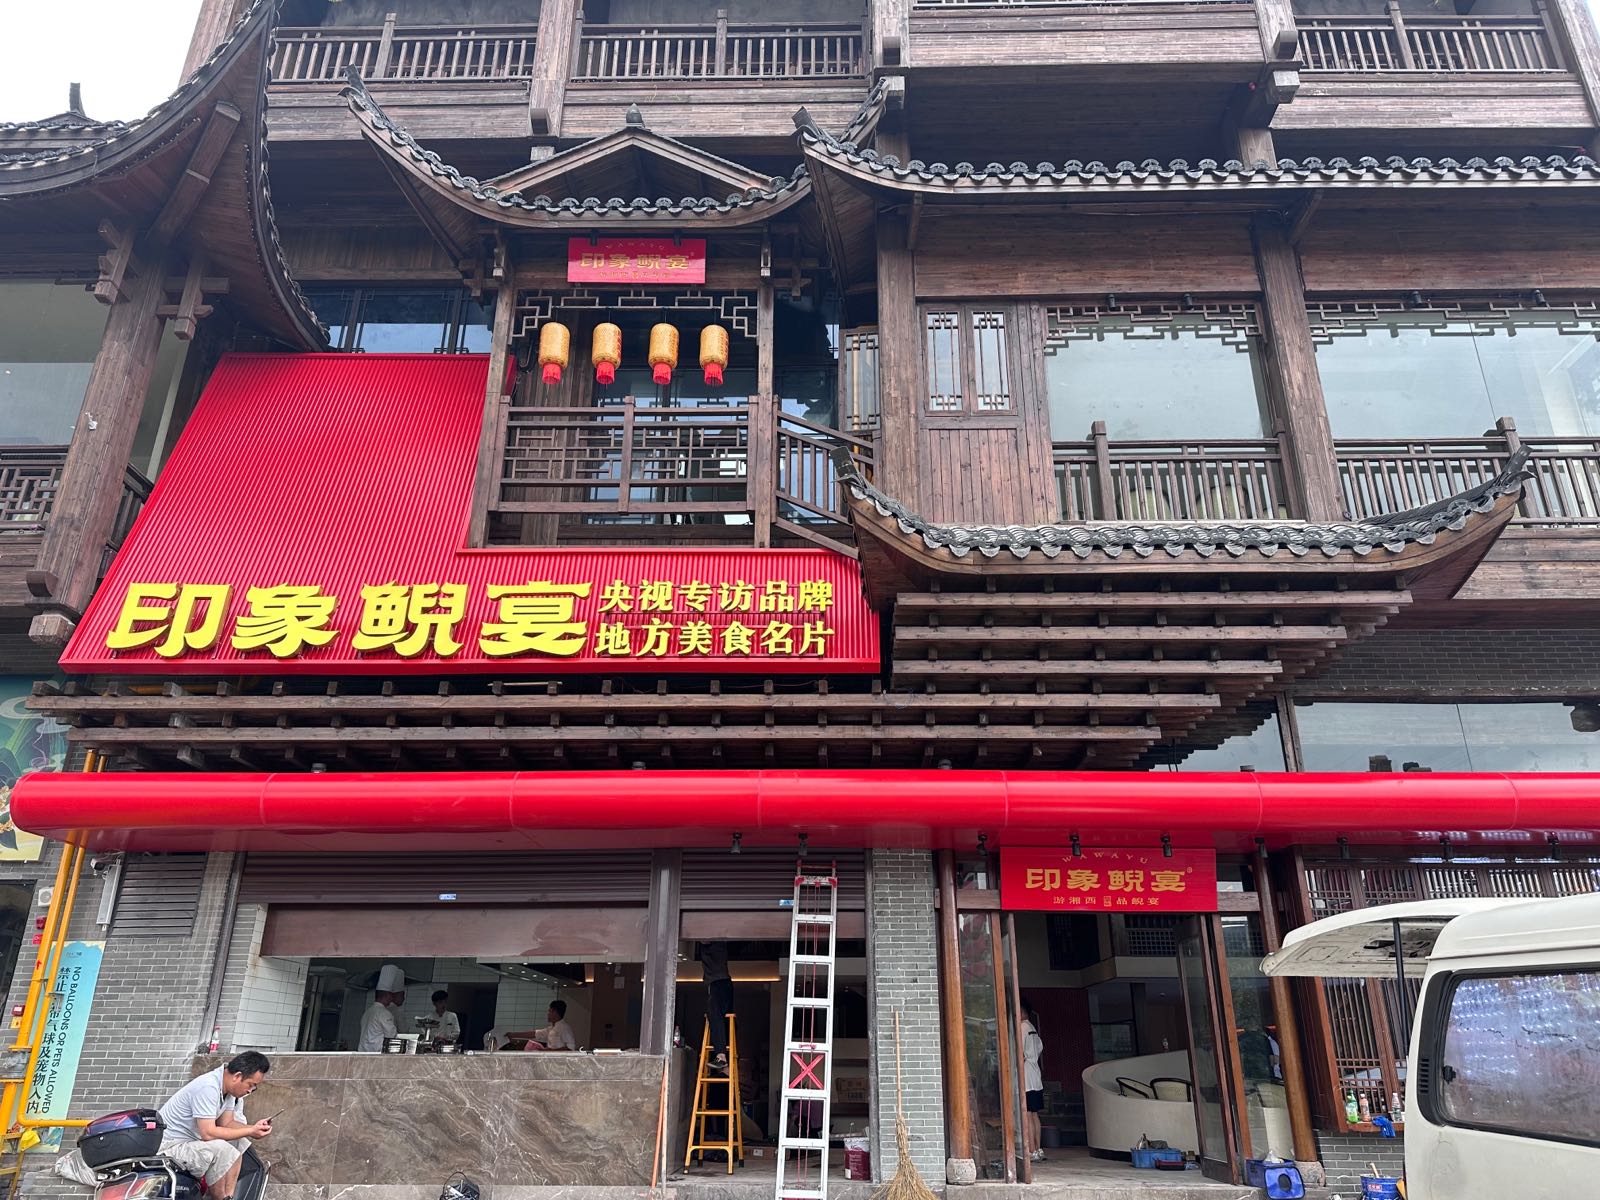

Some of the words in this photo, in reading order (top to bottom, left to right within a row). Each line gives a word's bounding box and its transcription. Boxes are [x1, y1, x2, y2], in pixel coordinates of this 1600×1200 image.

[580, 252, 689, 269] 印象鲵宴
[598, 579, 834, 613] 央视专访品牌
[106, 580, 593, 659] 印象鲵宴
[594, 618, 836, 657] 地方美食名片
[1062, 850, 1151, 864] WAWAYU
[1025, 868, 1186, 892] 印象鲵宴
[72, 967, 82, 981] NO
[61, 983, 78, 1031] BALLOONS
[57, 1034, 67, 1046] OR
[51, 1048, 62, 1067] PETS
[41, 1069, 58, 1114] ALLOWED
